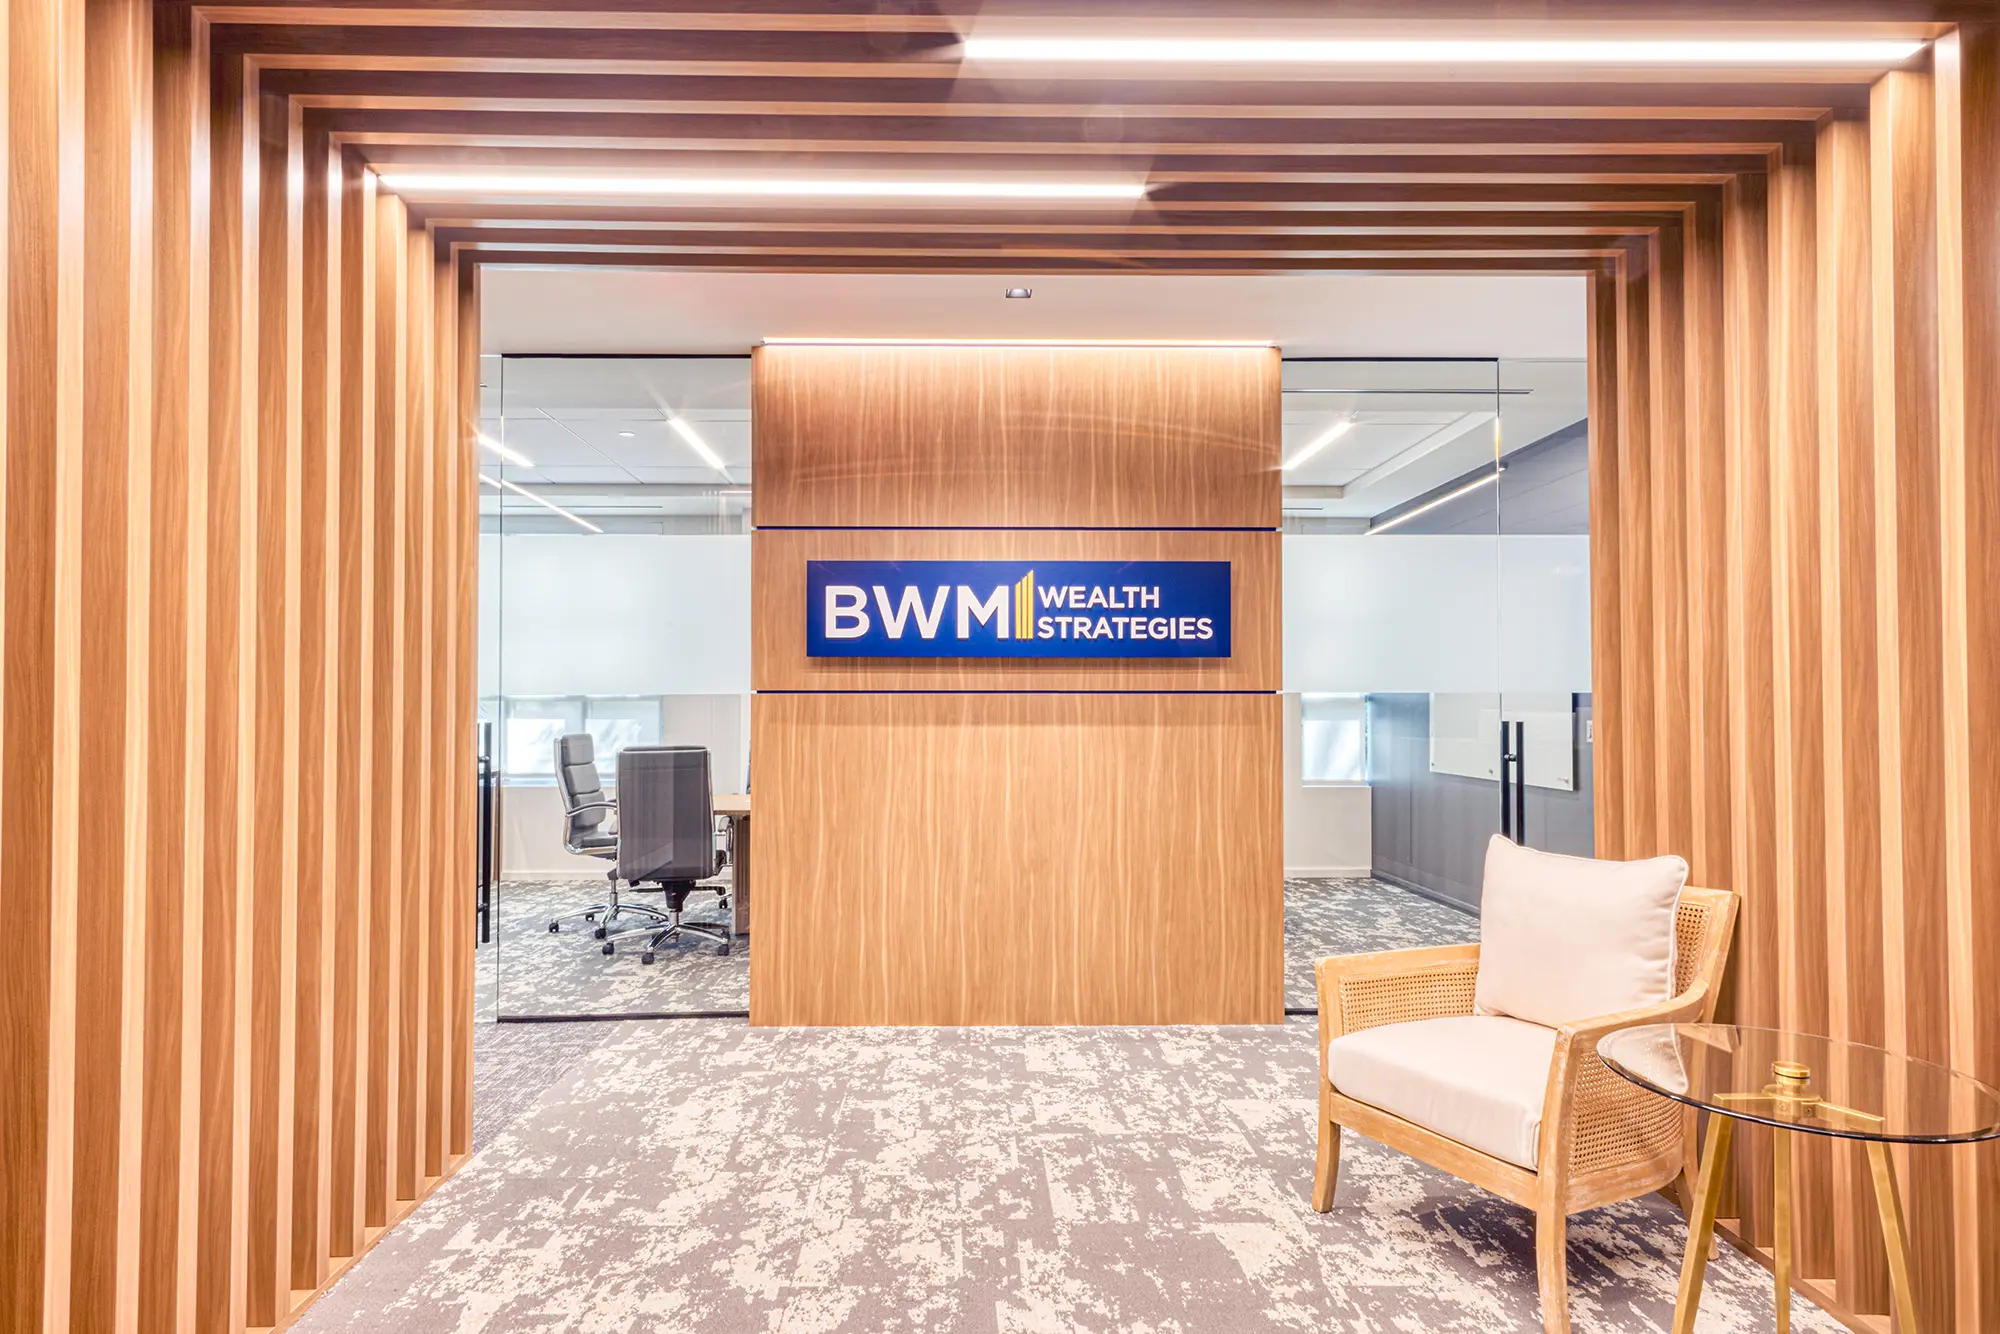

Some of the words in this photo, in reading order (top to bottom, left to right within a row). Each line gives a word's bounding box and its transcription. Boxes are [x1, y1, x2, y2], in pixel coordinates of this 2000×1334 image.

[1037, 585, 1160, 609] WEALTH
[825, 585, 1010, 639] BWM
[1037, 616, 1214, 640] STRATEGIES
